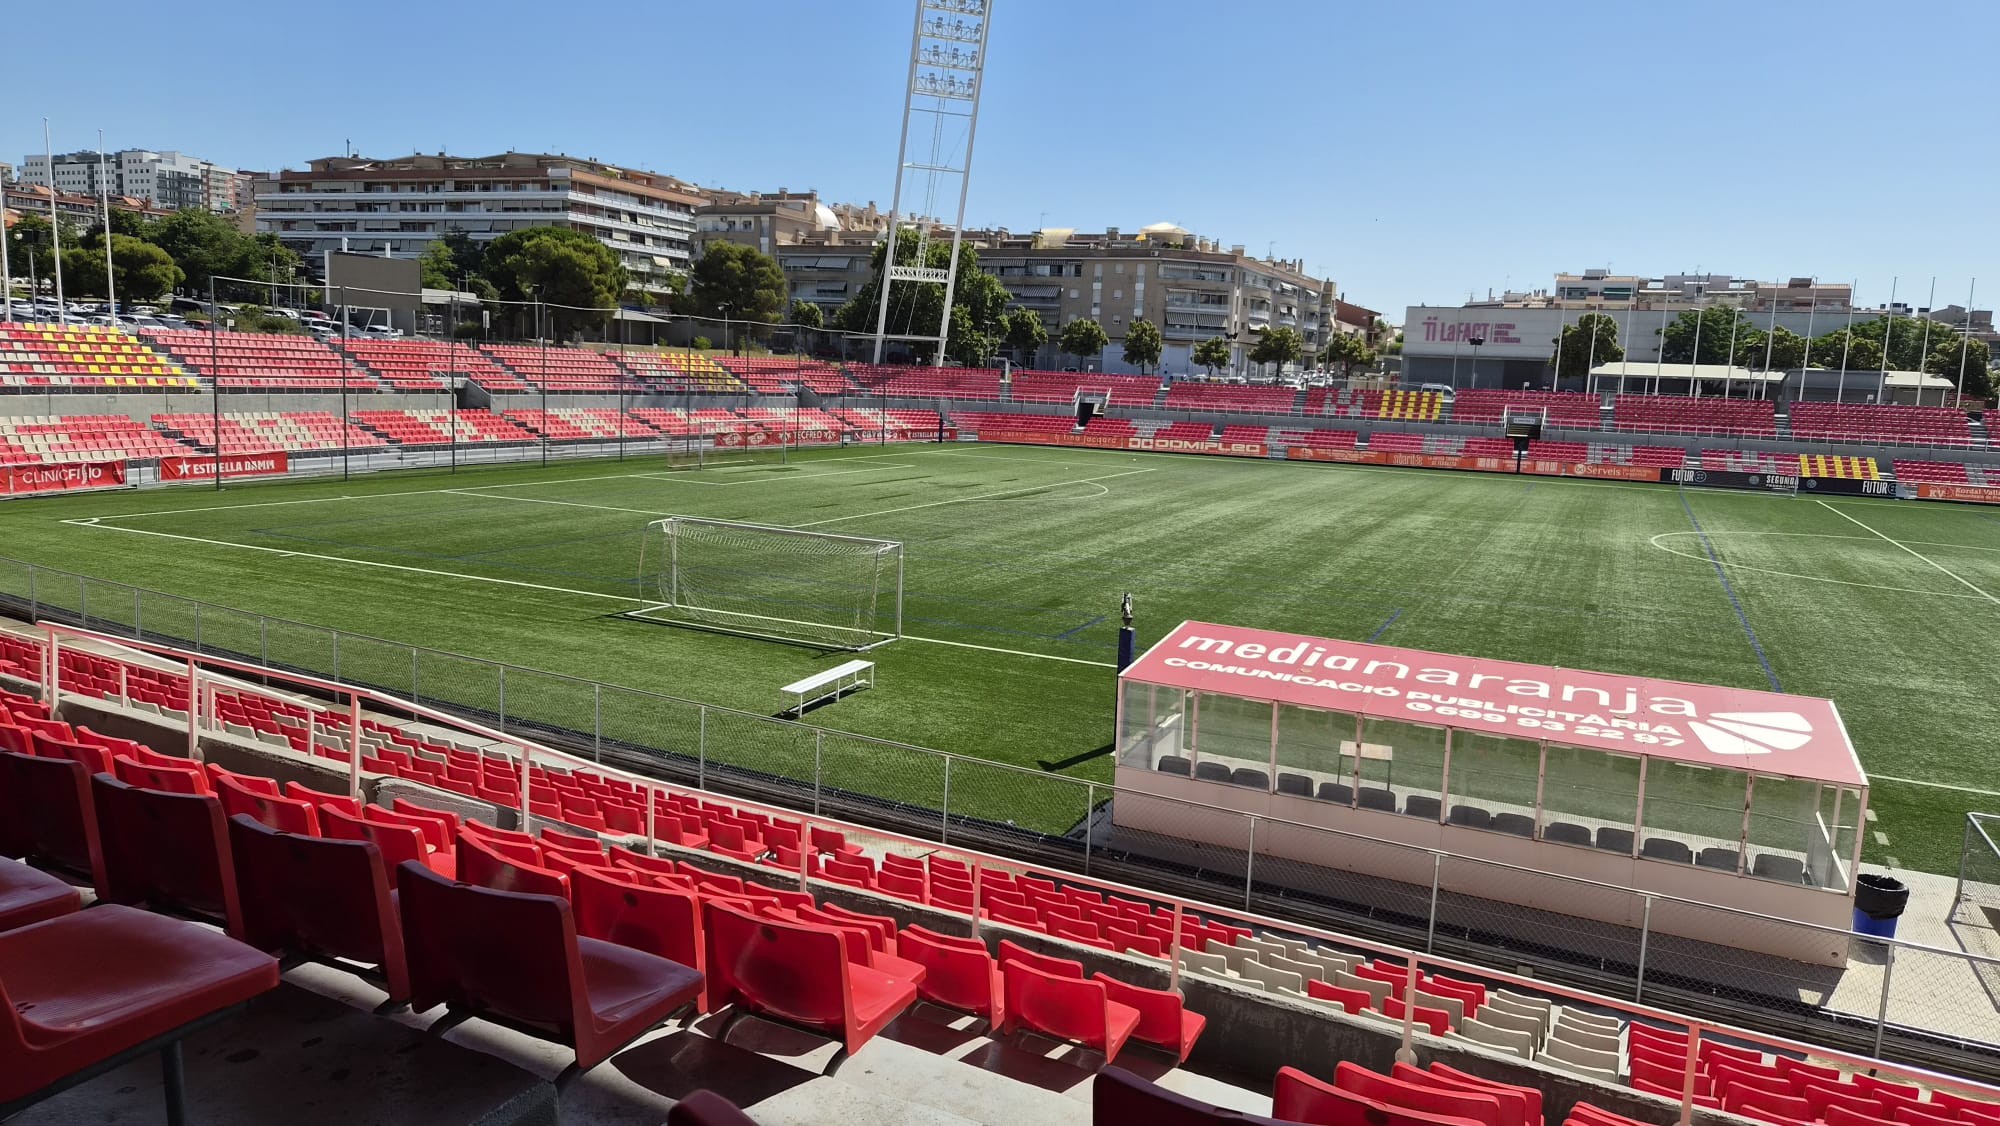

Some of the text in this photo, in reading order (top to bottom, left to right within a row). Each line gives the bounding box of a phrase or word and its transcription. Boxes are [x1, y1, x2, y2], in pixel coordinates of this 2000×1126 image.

[193, 459, 275, 474] ESTRELLA DAMM
[1587, 465, 1620, 476] Serveis
[1164, 657, 1400, 697] COMUNICACIÓ
[1179, 635, 1698, 718] medianaranja
[1435, 706, 1685, 747] 699 93 22 97
